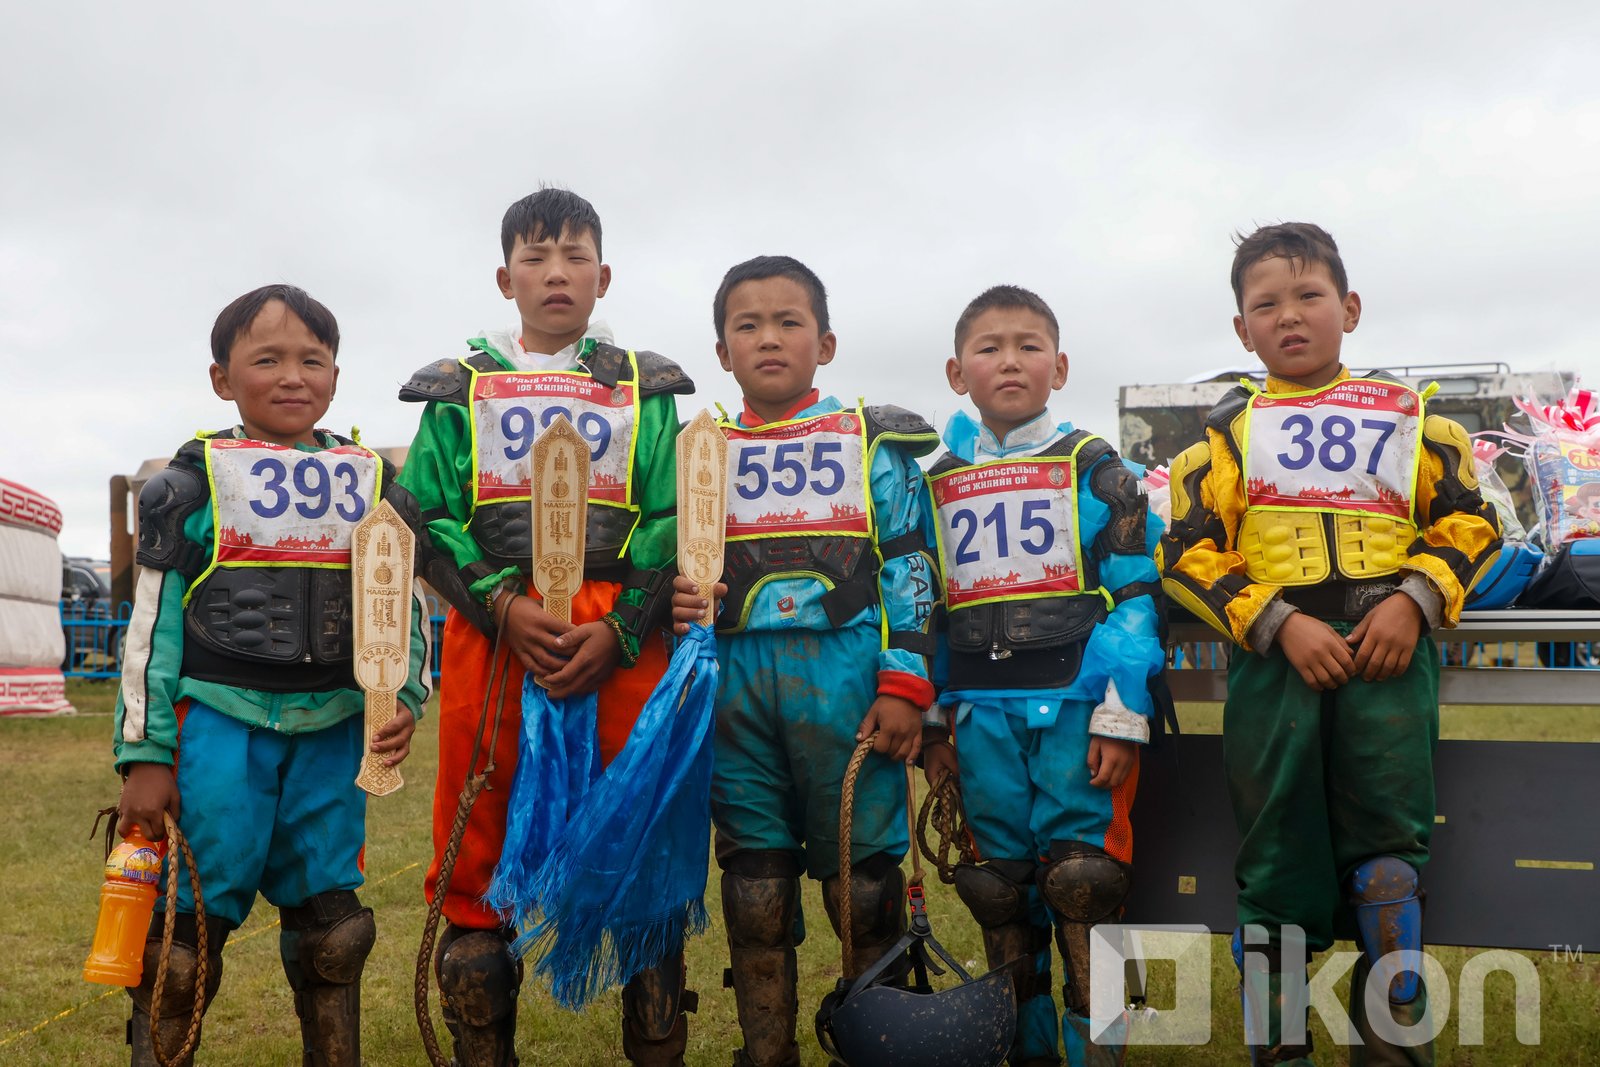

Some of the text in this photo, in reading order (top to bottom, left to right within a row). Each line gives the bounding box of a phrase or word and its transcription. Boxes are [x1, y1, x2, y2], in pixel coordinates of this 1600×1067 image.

[505, 375, 604, 390] АРДЫН ХУВЬСГАЛЫН
[516, 384, 532, 392] 105
[534, 383, 577, 394] ЖИЛИЙН
[1334, 384, 1389, 397] ВЬСГАЛЫН
[1361, 395, 1375, 405] ОЙ
[1277, 413, 1397, 476] 387
[735, 441, 846, 500] 555
[948, 465, 1039, 487] АРДЫН ХУВЬСГАЛЫН
[249, 456, 366, 523] 393
[958, 475, 1028, 494] 105 ЖИЛИЙН ОЙ
[950, 499, 1056, 566] 215
[540, 557, 578, 573] АЗАРГА
[694, 553, 711, 580] 3
[547, 566, 569, 596] 2
[362, 647, 402, 665] АЗАРГА
[374, 658, 389, 688] 1
